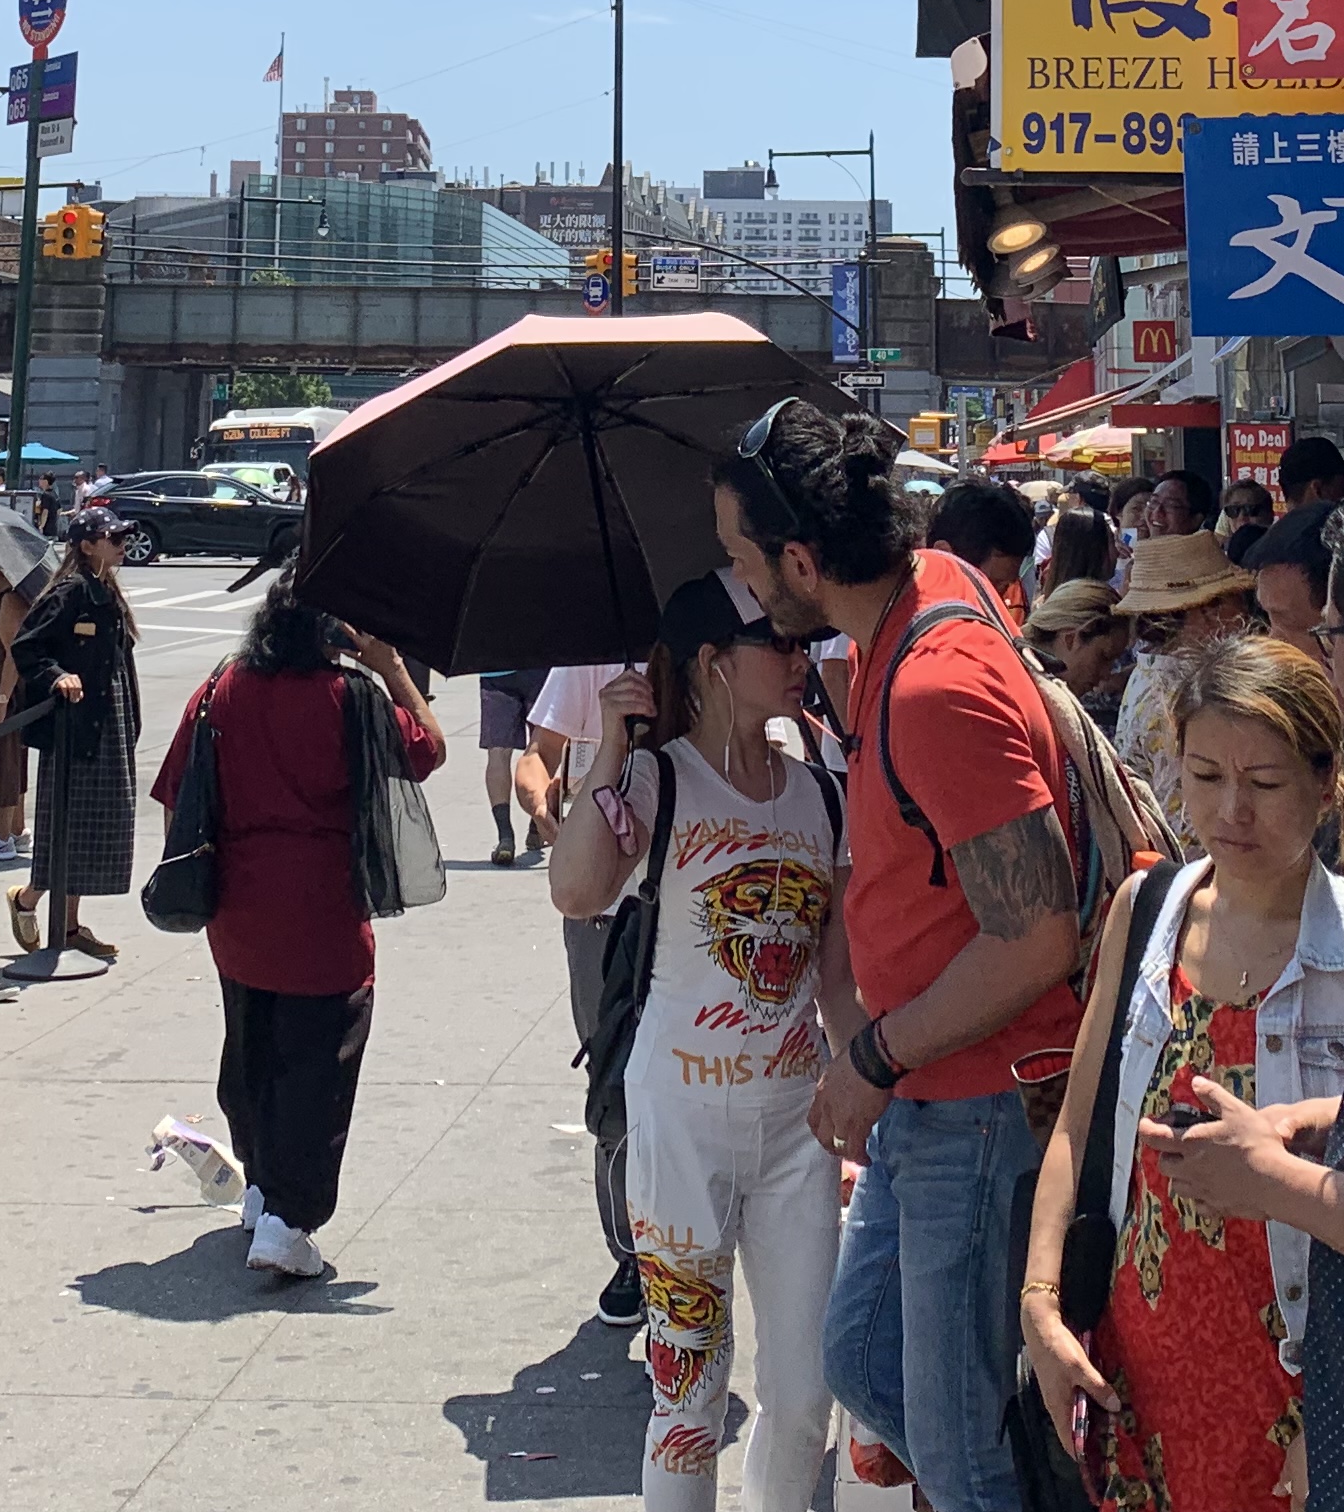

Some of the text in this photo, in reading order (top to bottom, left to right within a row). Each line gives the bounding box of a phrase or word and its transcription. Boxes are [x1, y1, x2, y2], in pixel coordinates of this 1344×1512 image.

[10, 69, 28, 92] Q65
[1026, 57, 1184, 90] BREEZE
[8, 97, 27, 121] Q65
[844, 270, 857, 312] WINDSOR
[875, 350, 887, 360] 40
[865, 376, 880, 384] WAY
[248, 427, 282, 441] COLLEGE
[1233, 429, 1287, 451] Top Deal
[671, 1047, 754, 1087] THIS
